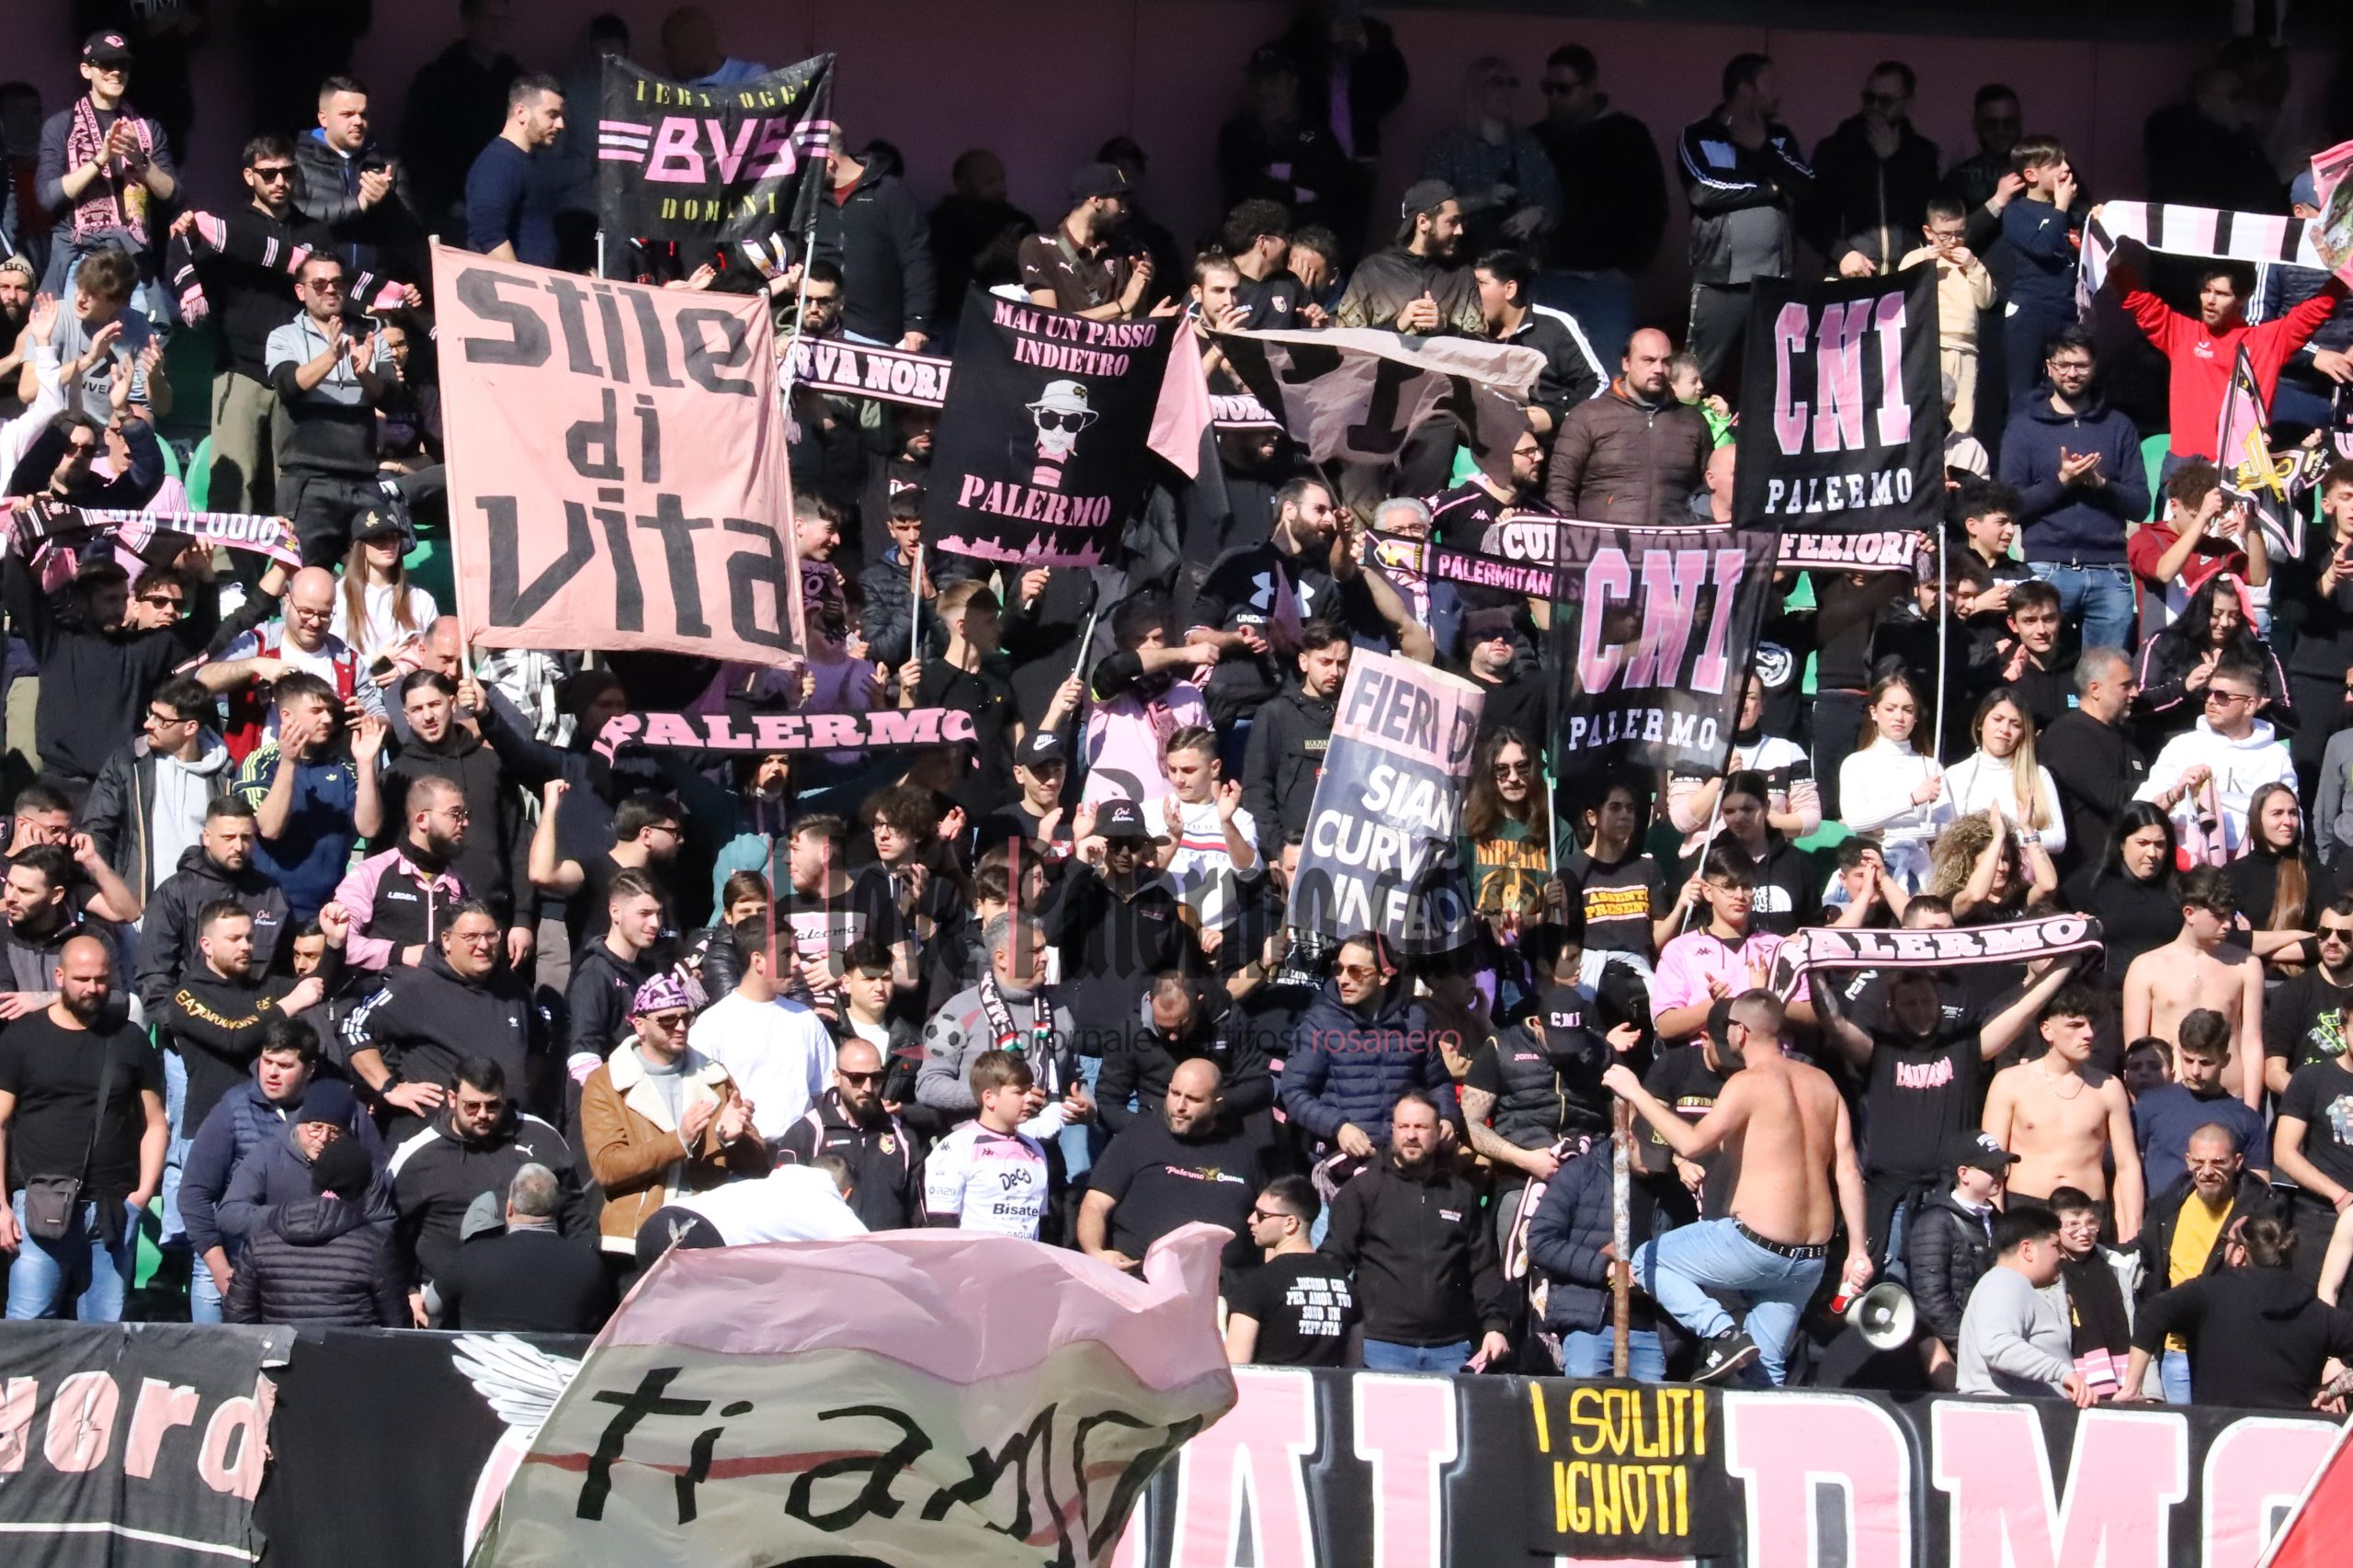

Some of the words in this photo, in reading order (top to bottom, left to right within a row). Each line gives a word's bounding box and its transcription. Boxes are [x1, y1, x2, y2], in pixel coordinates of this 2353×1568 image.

[993, 300, 1040, 334] MAI
[1046, 315, 1082, 341] UN
[1086, 322, 1157, 347] PASSO
[1013, 336, 1130, 377] INDIETRO
[1774, 290, 1912, 455] CNI
[565, 388, 662, 484] di
[958, 474, 1111, 528] PALERMO
[1765, 467, 1912, 514] PALERMO
[1577, 548, 1745, 695] CNI
[1344, 667, 1439, 753] FIERI
[1568, 708, 1718, 751] PALERMO
[1476, 838, 1549, 871] NIRVANA
[1286, 1291, 1306, 1305] PER
[1309, 1292, 1333, 1306] AMOR
[1302, 1306, 1324, 1321] SONO
[1327, 1306, 1341, 1321] UN
[1570, 1388, 1705, 1456] SOLITI
